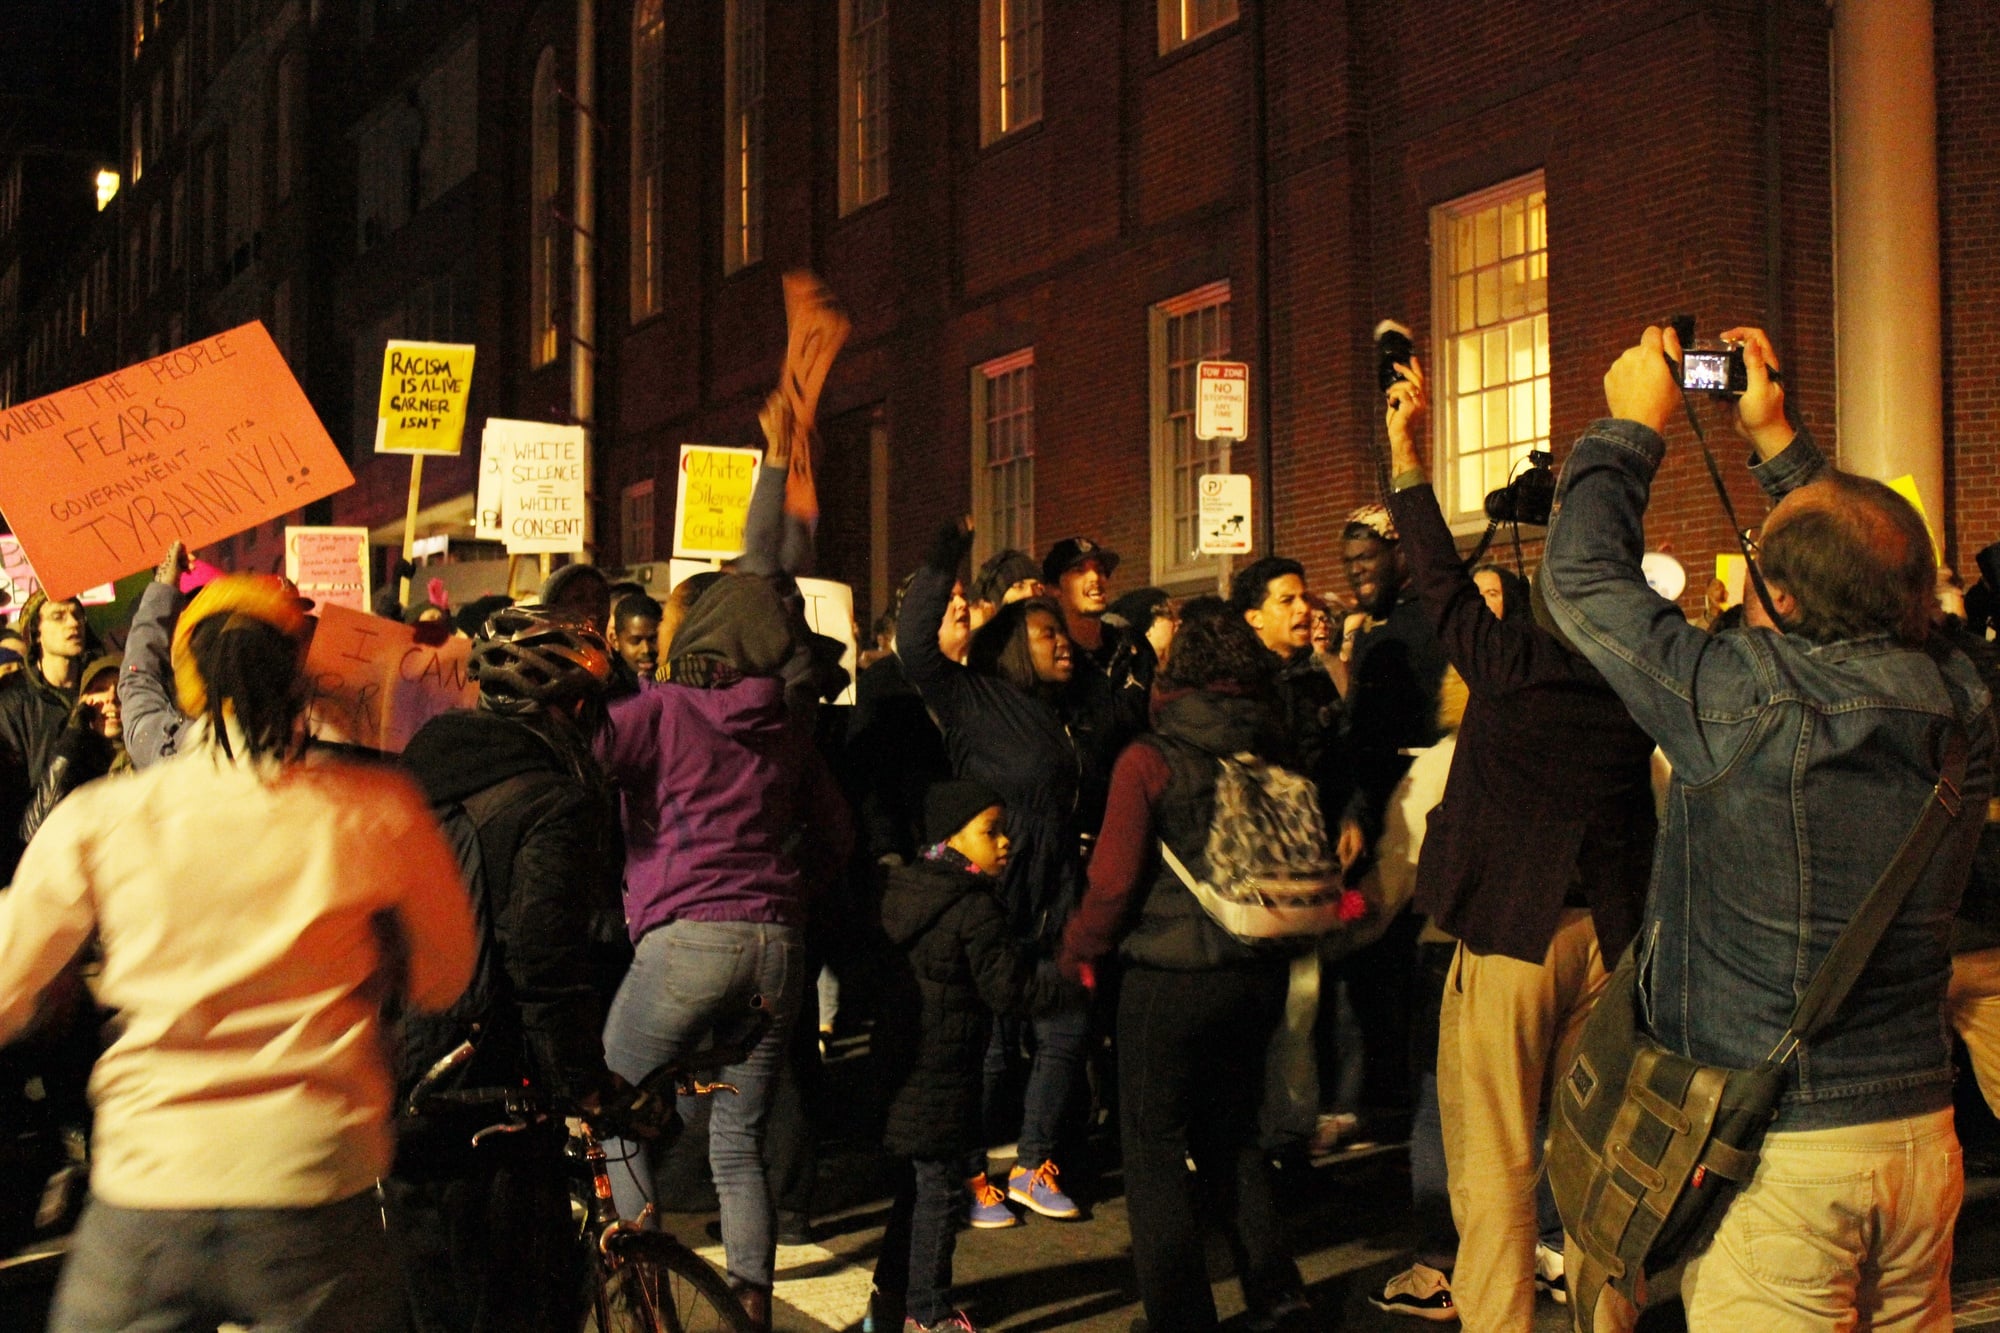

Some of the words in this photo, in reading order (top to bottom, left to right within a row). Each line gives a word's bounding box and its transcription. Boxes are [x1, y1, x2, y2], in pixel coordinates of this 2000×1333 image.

[391, 352, 452, 377] RACISM
[1202, 367, 1220, 377] TOW
[1224, 367, 1245, 378] ZONE
[0, 399, 64, 442] WHEN
[71, 373, 137, 409] THE
[141, 335, 237, 385] PEOPLE
[400, 378, 417, 394] IS
[421, 378, 463, 394] ALIVE
[1213, 382, 1233, 394] NO
[63, 397, 185, 464] FEARS
[127, 452, 160, 469] the
[513, 442, 575, 461] WHITE
[512, 464, 580, 484] SILENCE
[690, 451, 746, 480] White
[50, 449, 190, 521] GOVERNMENT
[688, 481, 746, 507] Silence
[520, 497, 572, 512] WHITE
[512, 518, 582, 537] CONSENT
[341, 627, 379, 664] I
